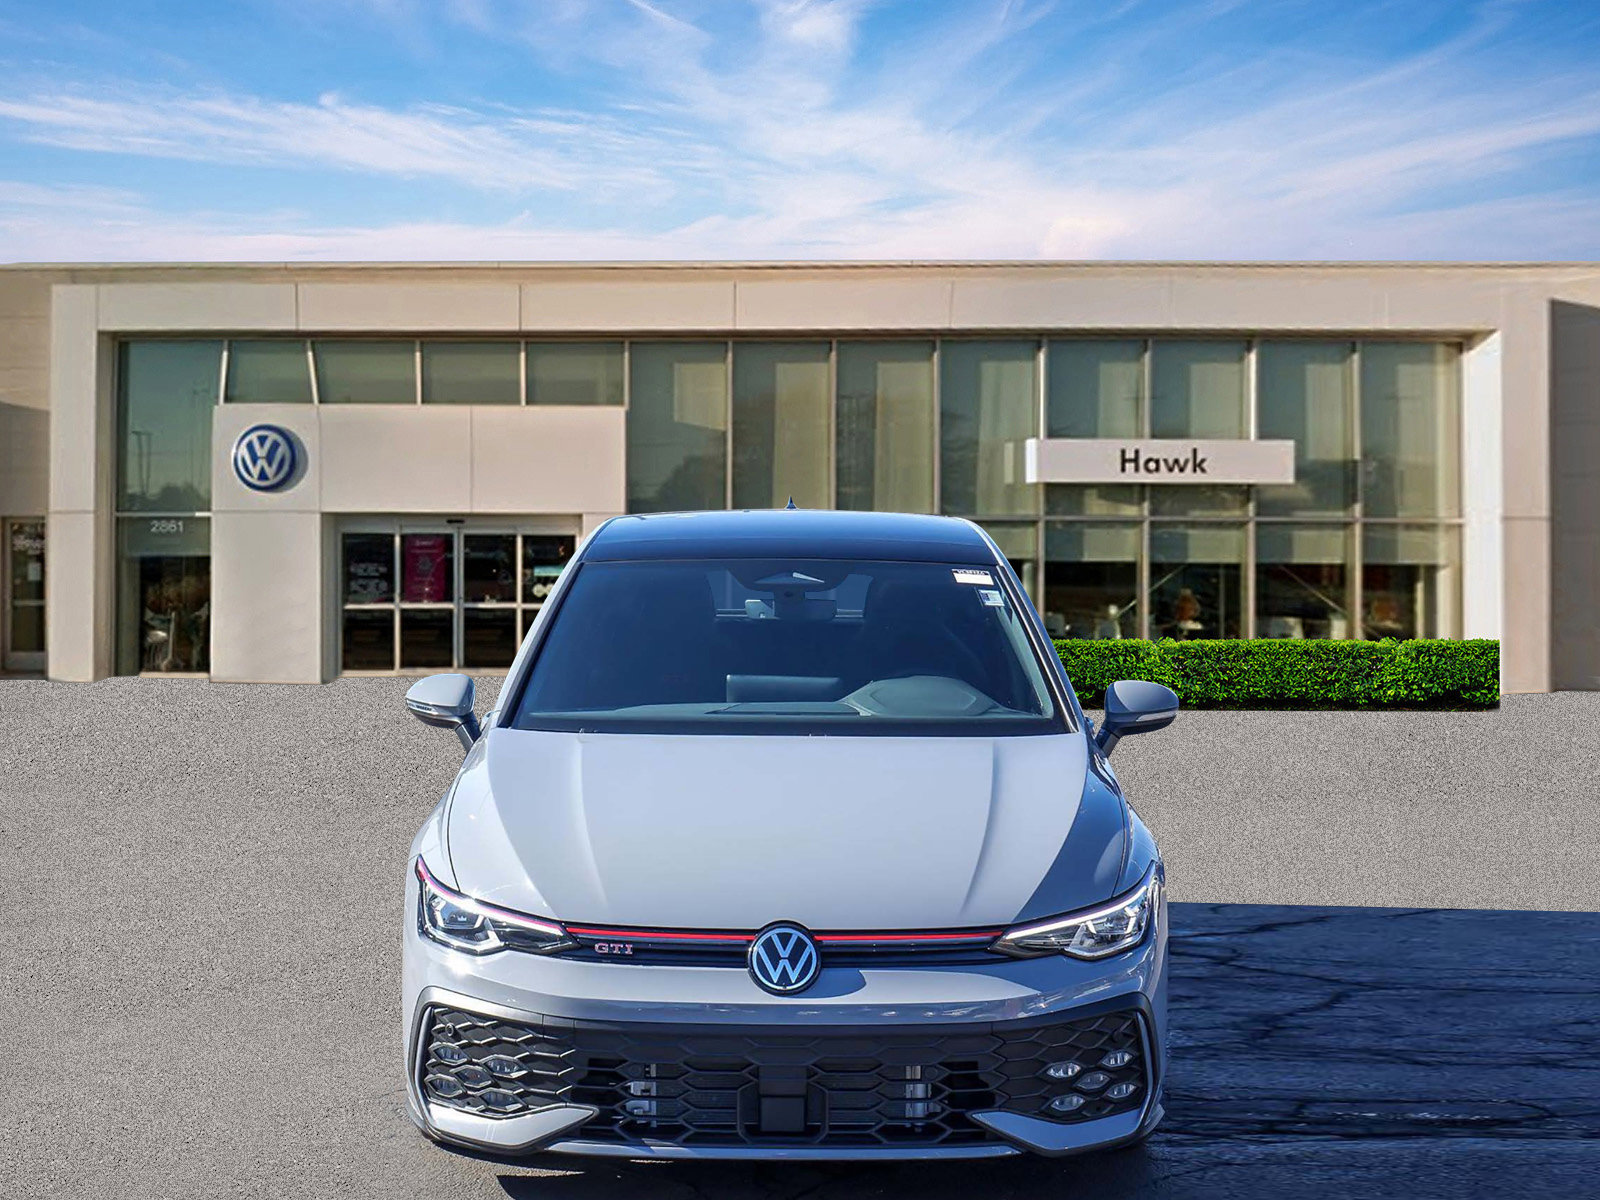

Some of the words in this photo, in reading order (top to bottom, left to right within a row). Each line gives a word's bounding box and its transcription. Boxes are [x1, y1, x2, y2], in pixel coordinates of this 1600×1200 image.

[237, 430, 291, 486] VW
[1120, 447, 1207, 474] Hawk
[594, 942, 633, 955] GTI
[753, 928, 817, 989] VW
